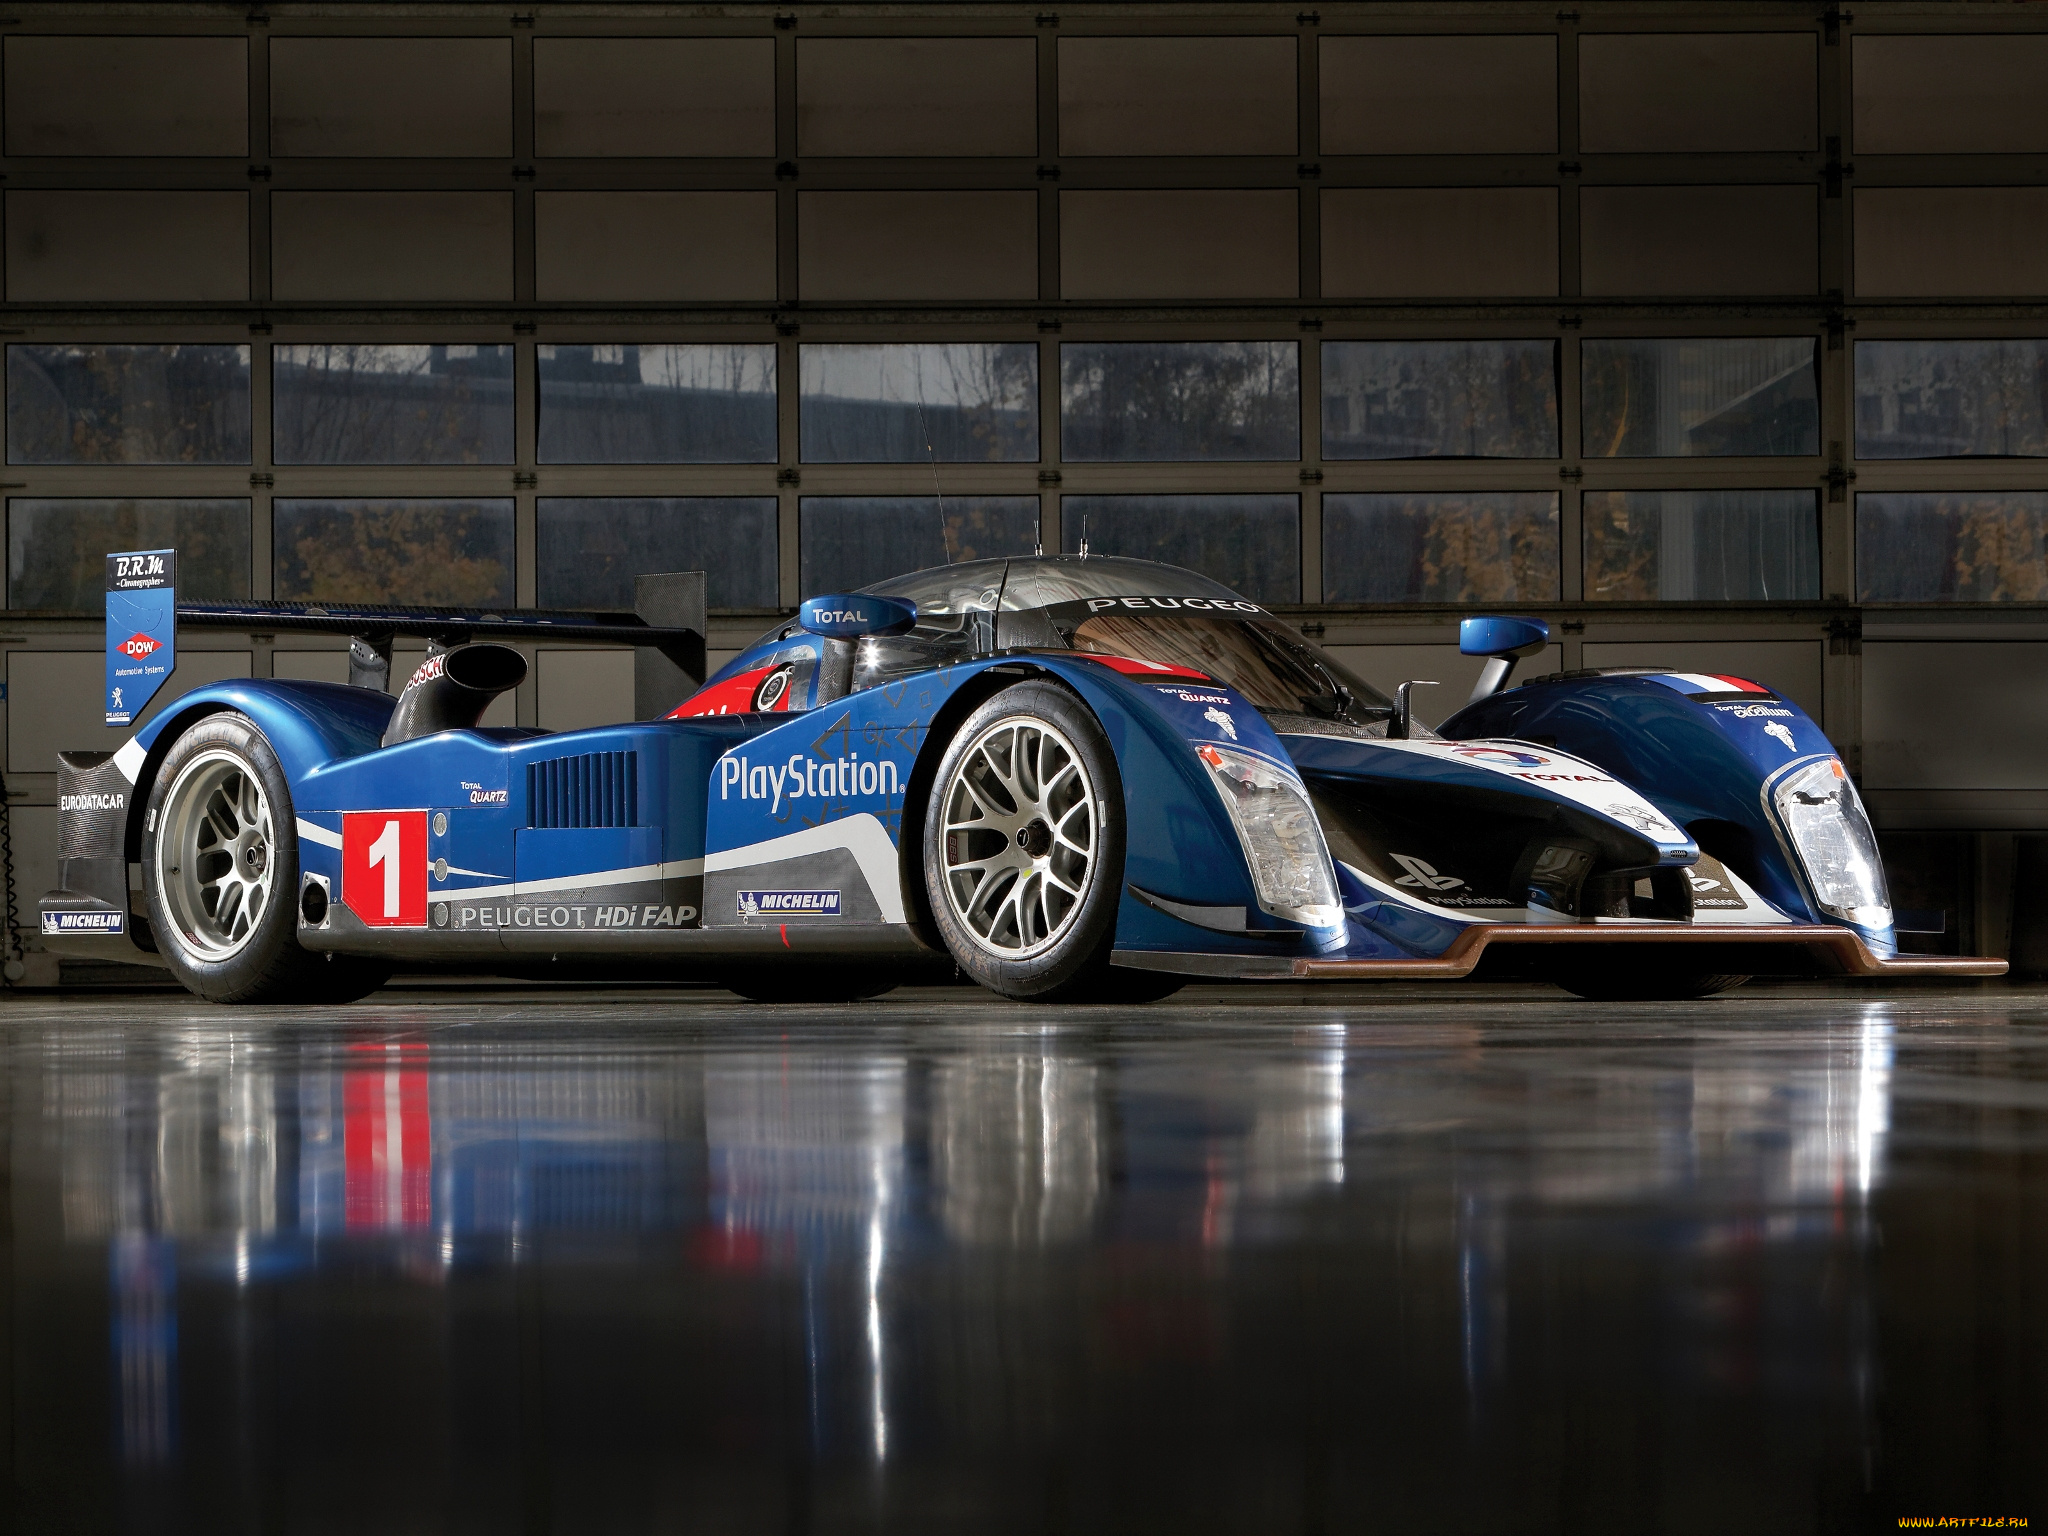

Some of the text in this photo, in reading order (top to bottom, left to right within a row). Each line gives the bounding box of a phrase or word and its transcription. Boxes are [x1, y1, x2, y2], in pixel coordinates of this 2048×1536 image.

[116, 555, 164, 576] B.R.M
[1087, 597, 1262, 613] PEUGEO
[813, 609, 867, 623] TOTAL
[127, 640, 154, 654] DOW
[1180, 694, 1231, 704] QUARTZ
[1509, 772, 1615, 783] TOTAL
[461, 781, 482, 789] TOTAL
[61, 794, 124, 811] EURODATACAR
[470, 790, 506, 803] QUARTZ
[369, 821, 399, 918] 1
[761, 894, 838, 908] MICHELIN
[60, 915, 121, 927] MICHELIN
[461, 906, 697, 927] PEUGEOT HDi FAP
